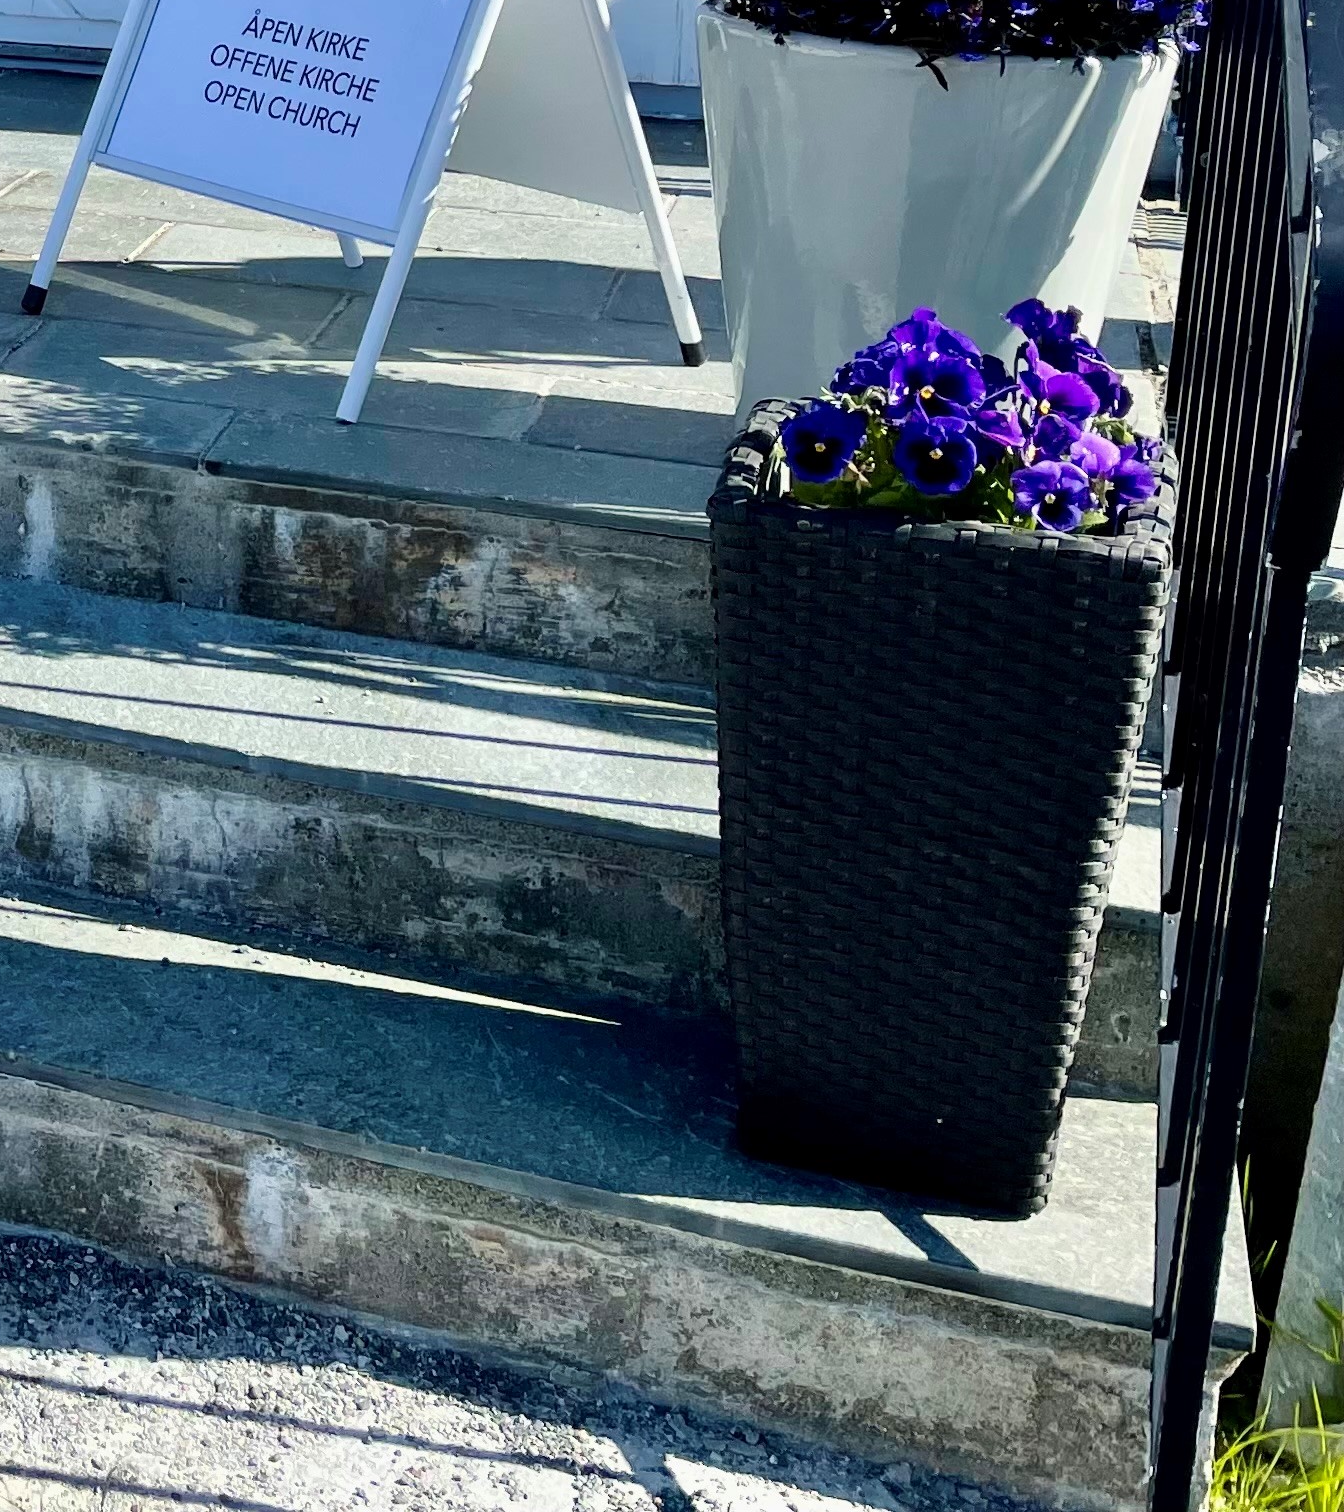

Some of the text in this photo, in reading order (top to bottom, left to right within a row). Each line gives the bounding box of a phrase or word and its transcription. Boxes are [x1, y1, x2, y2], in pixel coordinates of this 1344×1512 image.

[241, 8, 370, 62] ÅPEN KIRKE
[210, 44, 381, 103] OFFENE KIRCHE
[204, 80, 362, 139] OPEN CHURCH
